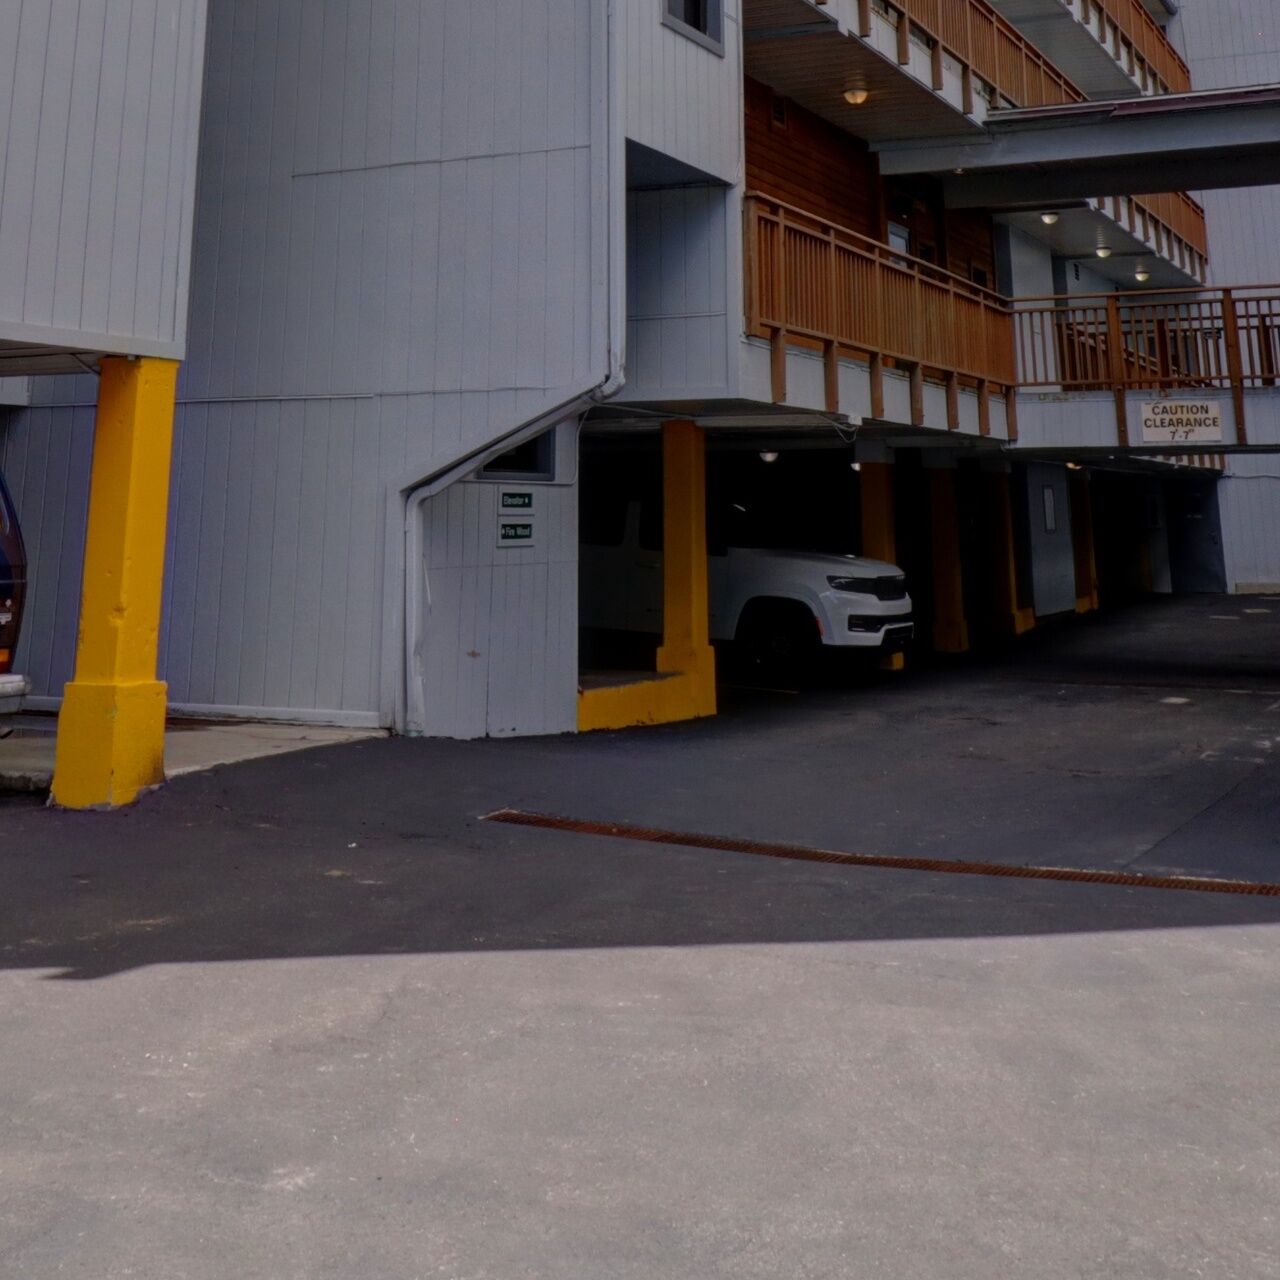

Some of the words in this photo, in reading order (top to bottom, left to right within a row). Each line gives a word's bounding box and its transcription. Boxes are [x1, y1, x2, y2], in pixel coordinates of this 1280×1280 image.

[1152, 405, 1209, 416] CAUTION
[1144, 417, 1219, 428] CLEARANCE
[504, 496, 524, 504] Elevator
